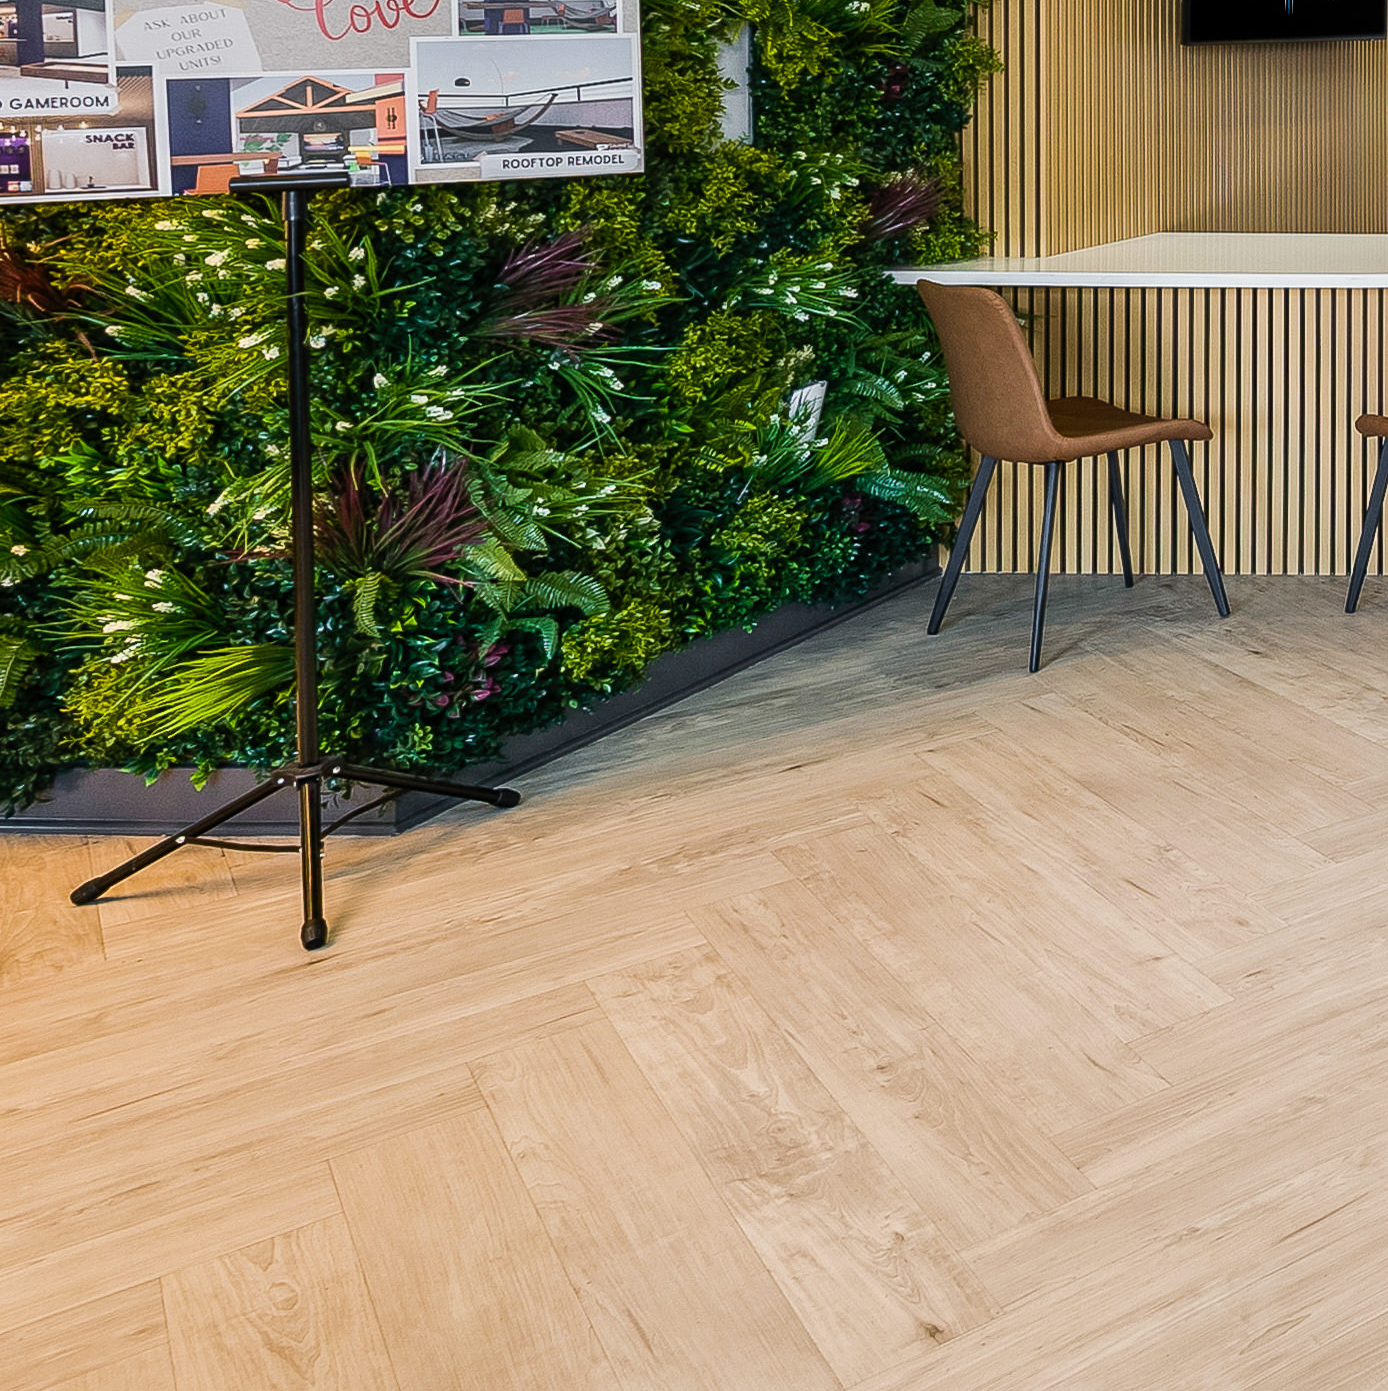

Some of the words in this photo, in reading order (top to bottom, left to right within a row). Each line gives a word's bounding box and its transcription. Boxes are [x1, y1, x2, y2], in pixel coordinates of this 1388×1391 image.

[144, 19, 172, 31] ASK
[180, 9, 227, 24] ABOUT
[171, 28, 202, 41] OUR
[156, 38, 234, 60] UPGRADED
[179, 55, 222, 71] UNITS!
[9, 96, 109, 110] GAMEROOM
[85, 133, 135, 143] SNACK
[112, 142, 135, 150] BAR
[502, 156, 563, 169] ROOFTOP
[567, 153, 625, 167] REMODEL
